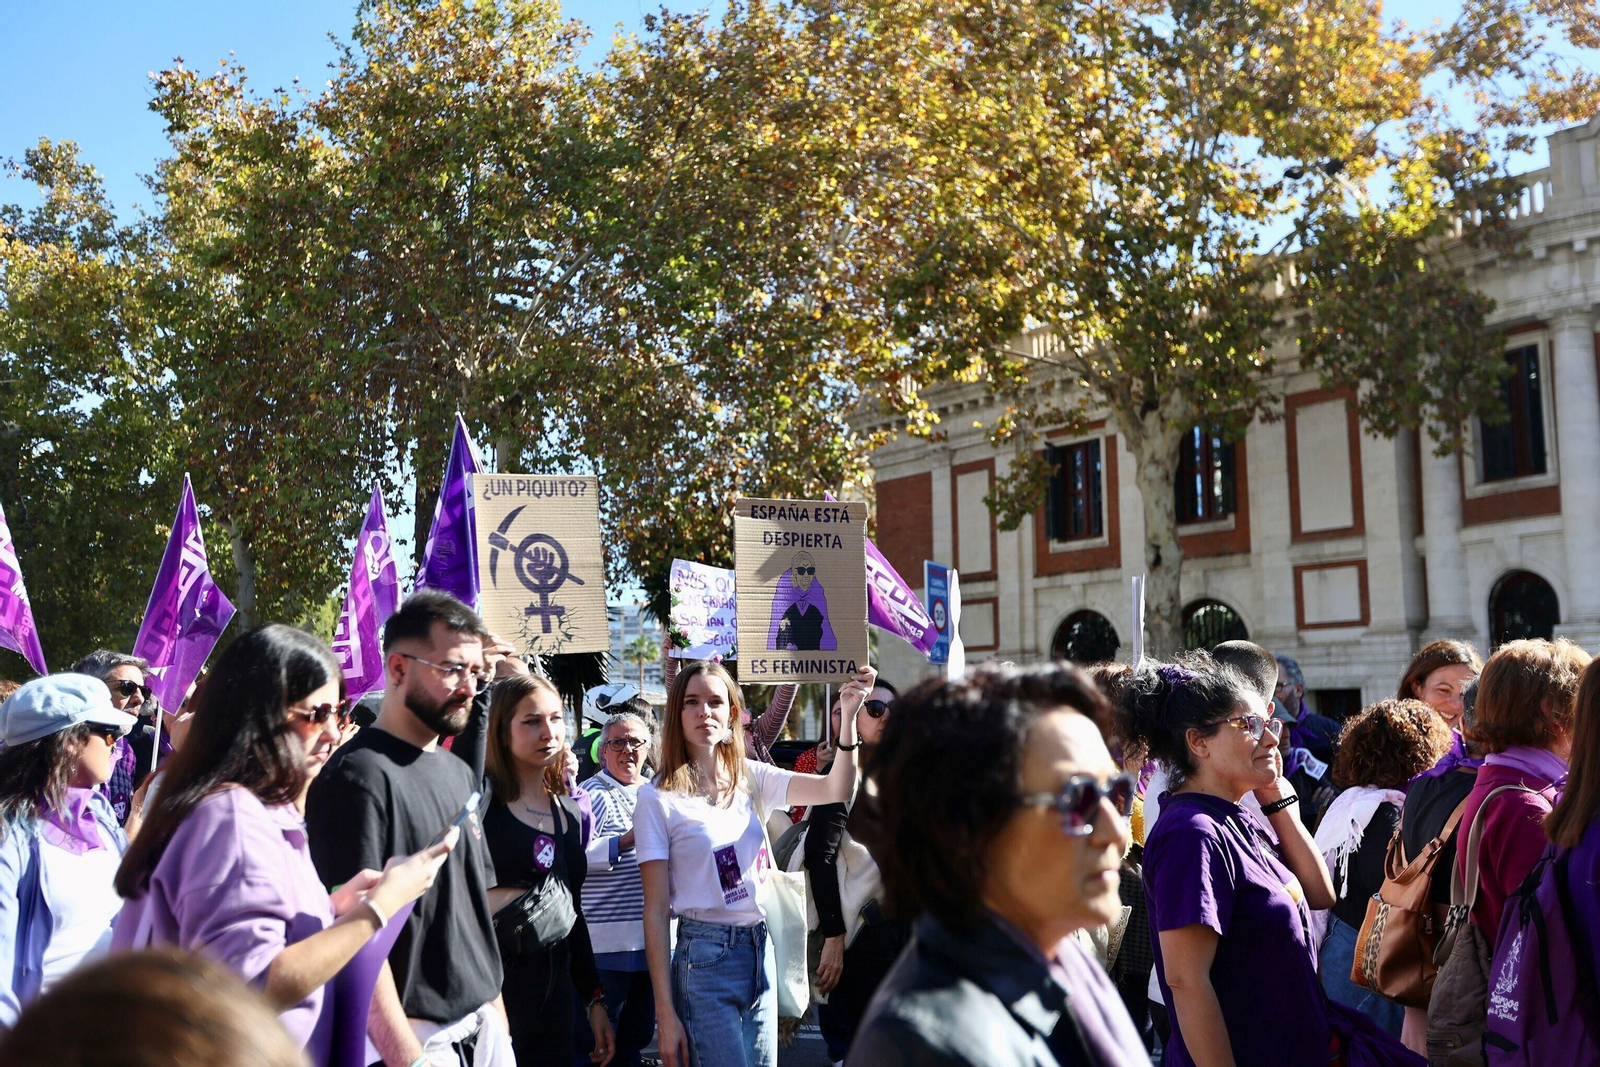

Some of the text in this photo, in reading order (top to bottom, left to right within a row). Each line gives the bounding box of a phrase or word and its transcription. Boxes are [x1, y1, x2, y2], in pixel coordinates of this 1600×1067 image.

[482, 478, 587, 500] ¿UN PIQUITO?
[750, 502, 850, 524] ESPAÑA ESTÁ
[763, 530, 843, 549] DESPIERTA
[751, 658, 858, 675] ES FEMINISTA
